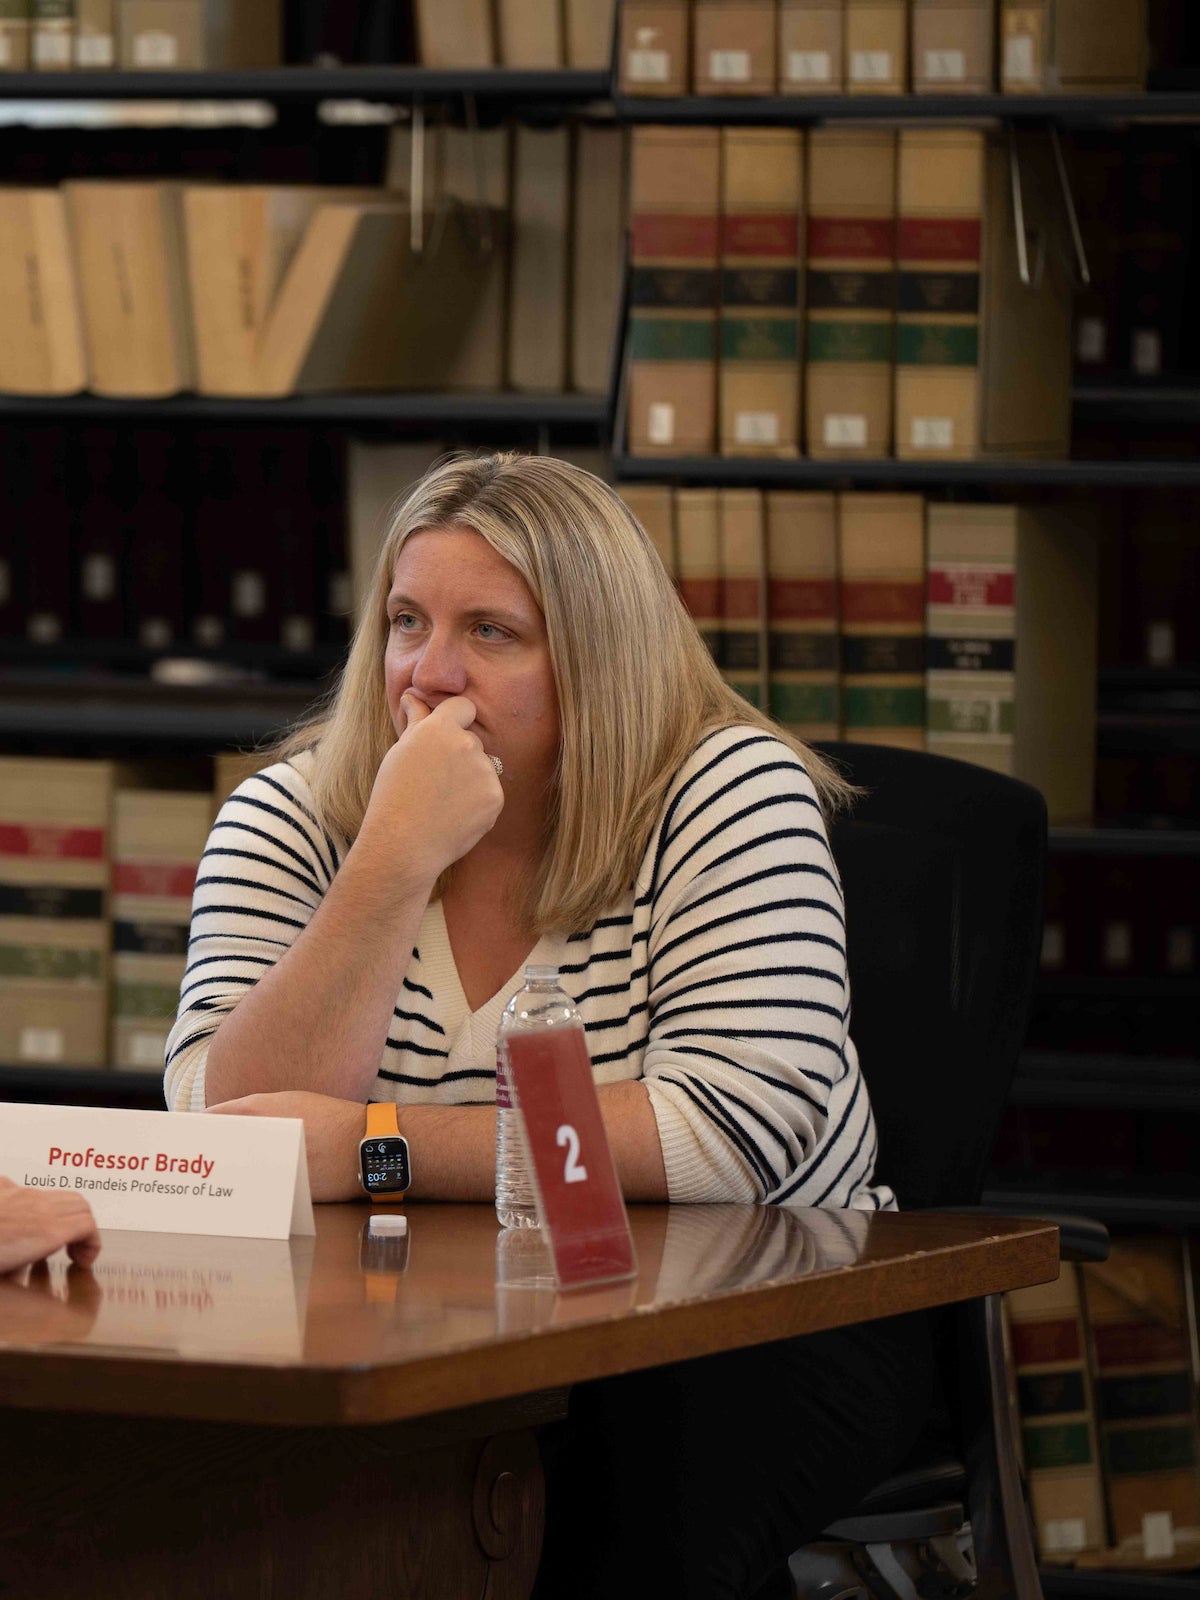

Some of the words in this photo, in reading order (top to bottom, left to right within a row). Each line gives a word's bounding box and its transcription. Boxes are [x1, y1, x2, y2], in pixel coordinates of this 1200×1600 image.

[48, 1147, 150, 1171] Professor
[155, 1153, 215, 1179] Brady
[556, 1124, 588, 1184] 2
[24, 1173, 56, 1188] Louis
[59, 1175, 71, 1188] D.
[74, 1176, 128, 1192] Brandeis
[130, 1179, 189, 1195] Professor
[192, 1183, 206, 1196] of
[208, 1184, 234, 1198] Law
[367, 1172, 387, 1182] 2:03
